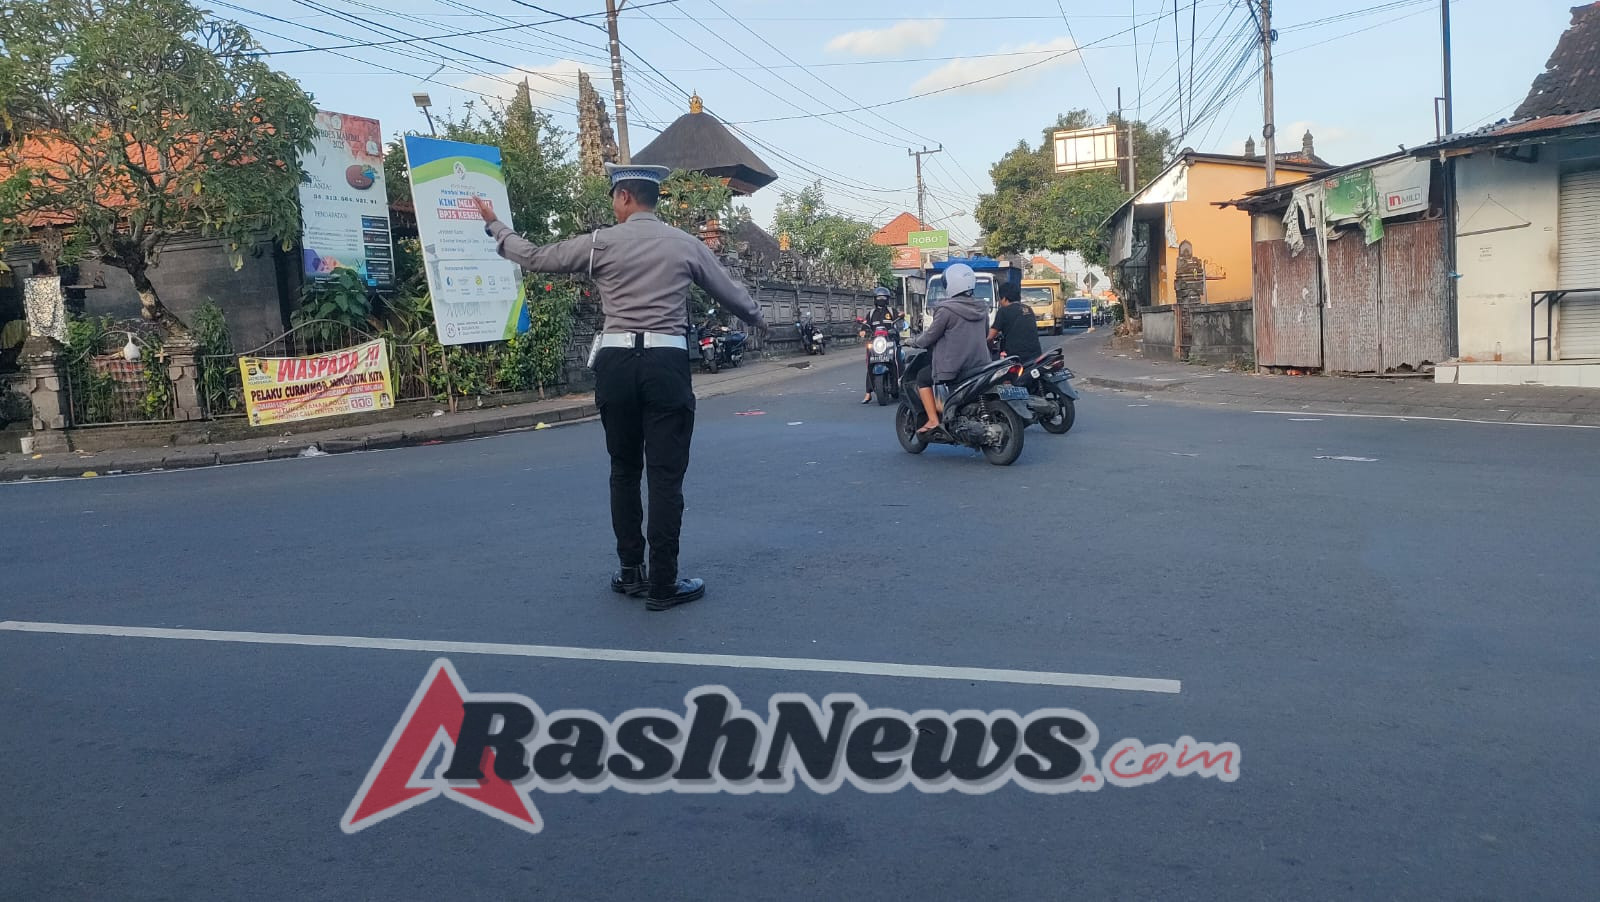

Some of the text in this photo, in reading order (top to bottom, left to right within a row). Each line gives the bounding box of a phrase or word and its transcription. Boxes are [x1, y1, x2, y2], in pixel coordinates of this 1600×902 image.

[912, 235, 944, 244] ROBOT
[277, 351, 359, 382] WASPADA
[251, 387, 283, 402] PELAKU
